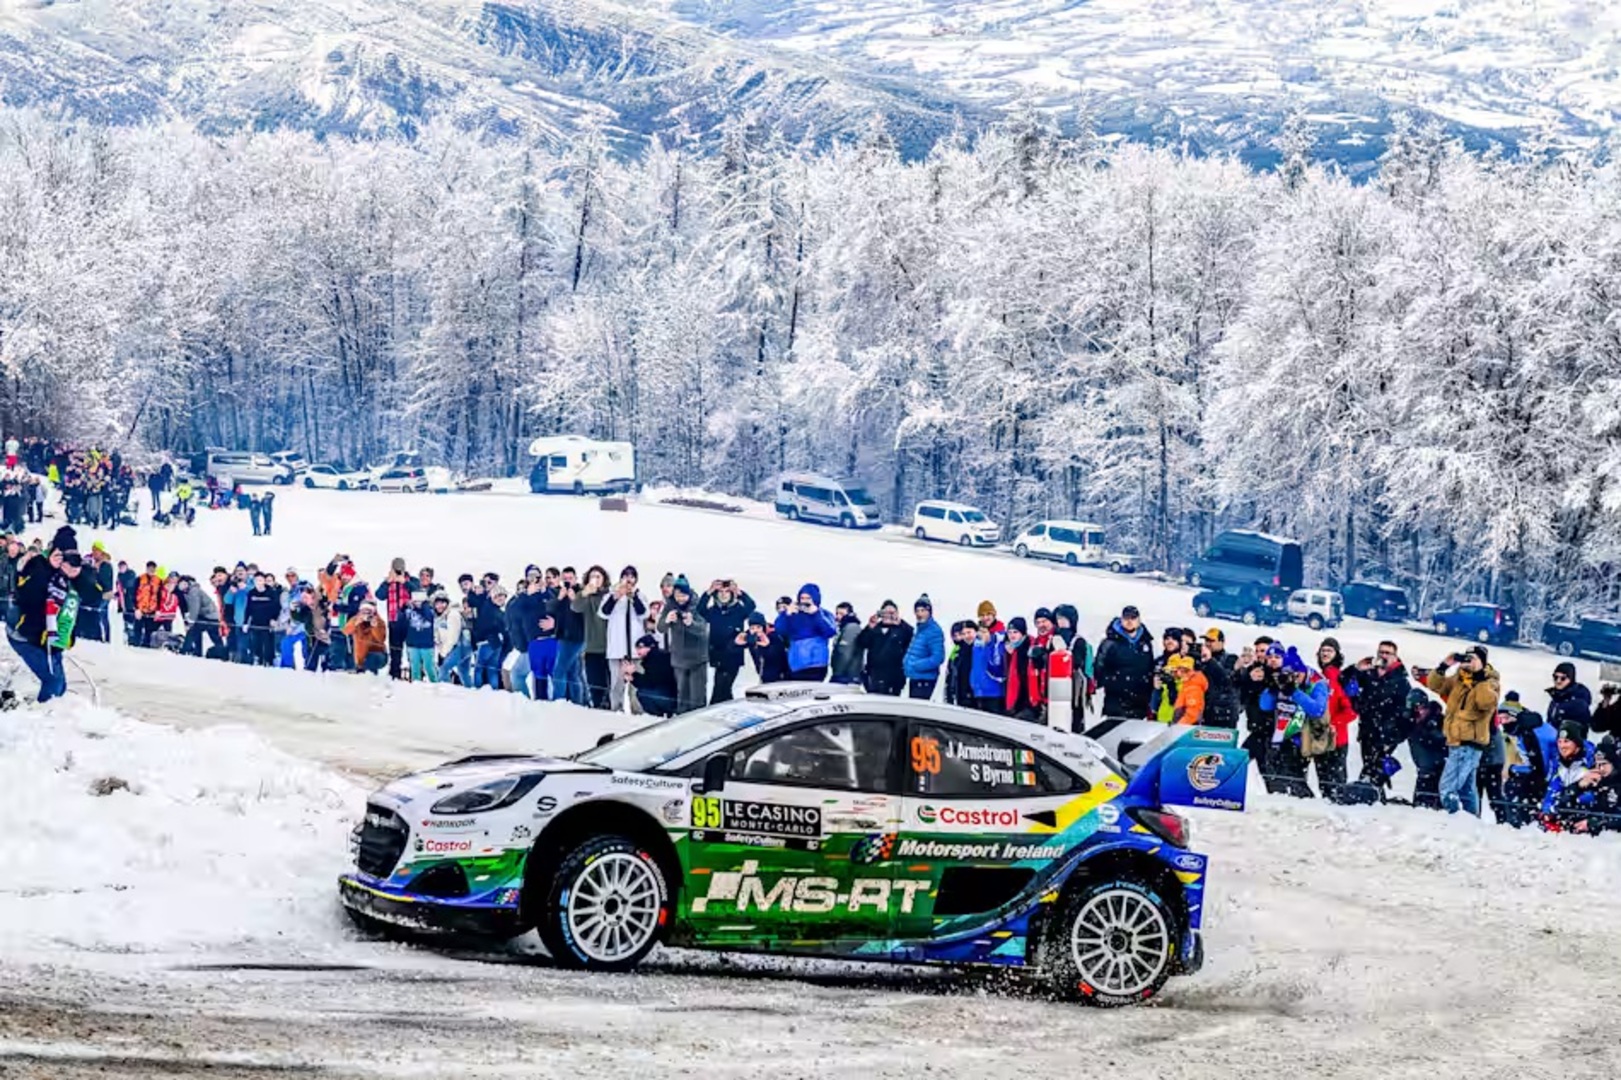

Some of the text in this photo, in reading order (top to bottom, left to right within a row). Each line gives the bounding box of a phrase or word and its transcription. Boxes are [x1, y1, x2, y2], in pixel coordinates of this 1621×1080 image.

[911, 736, 941, 775] 95
[957, 741, 1013, 767] Armstrong
[611, 775, 684, 789] SafetyCulture
[970, 763, 1014, 787] S Byrne
[692, 796, 721, 829] 95
[724, 802, 744, 818] LE
[746, 804, 820, 825] CASINO
[939, 807, 1018, 826] Castrol
[425, 839, 472, 852] Castrol
[898, 840, 1066, 860] Motorsport Ireland
